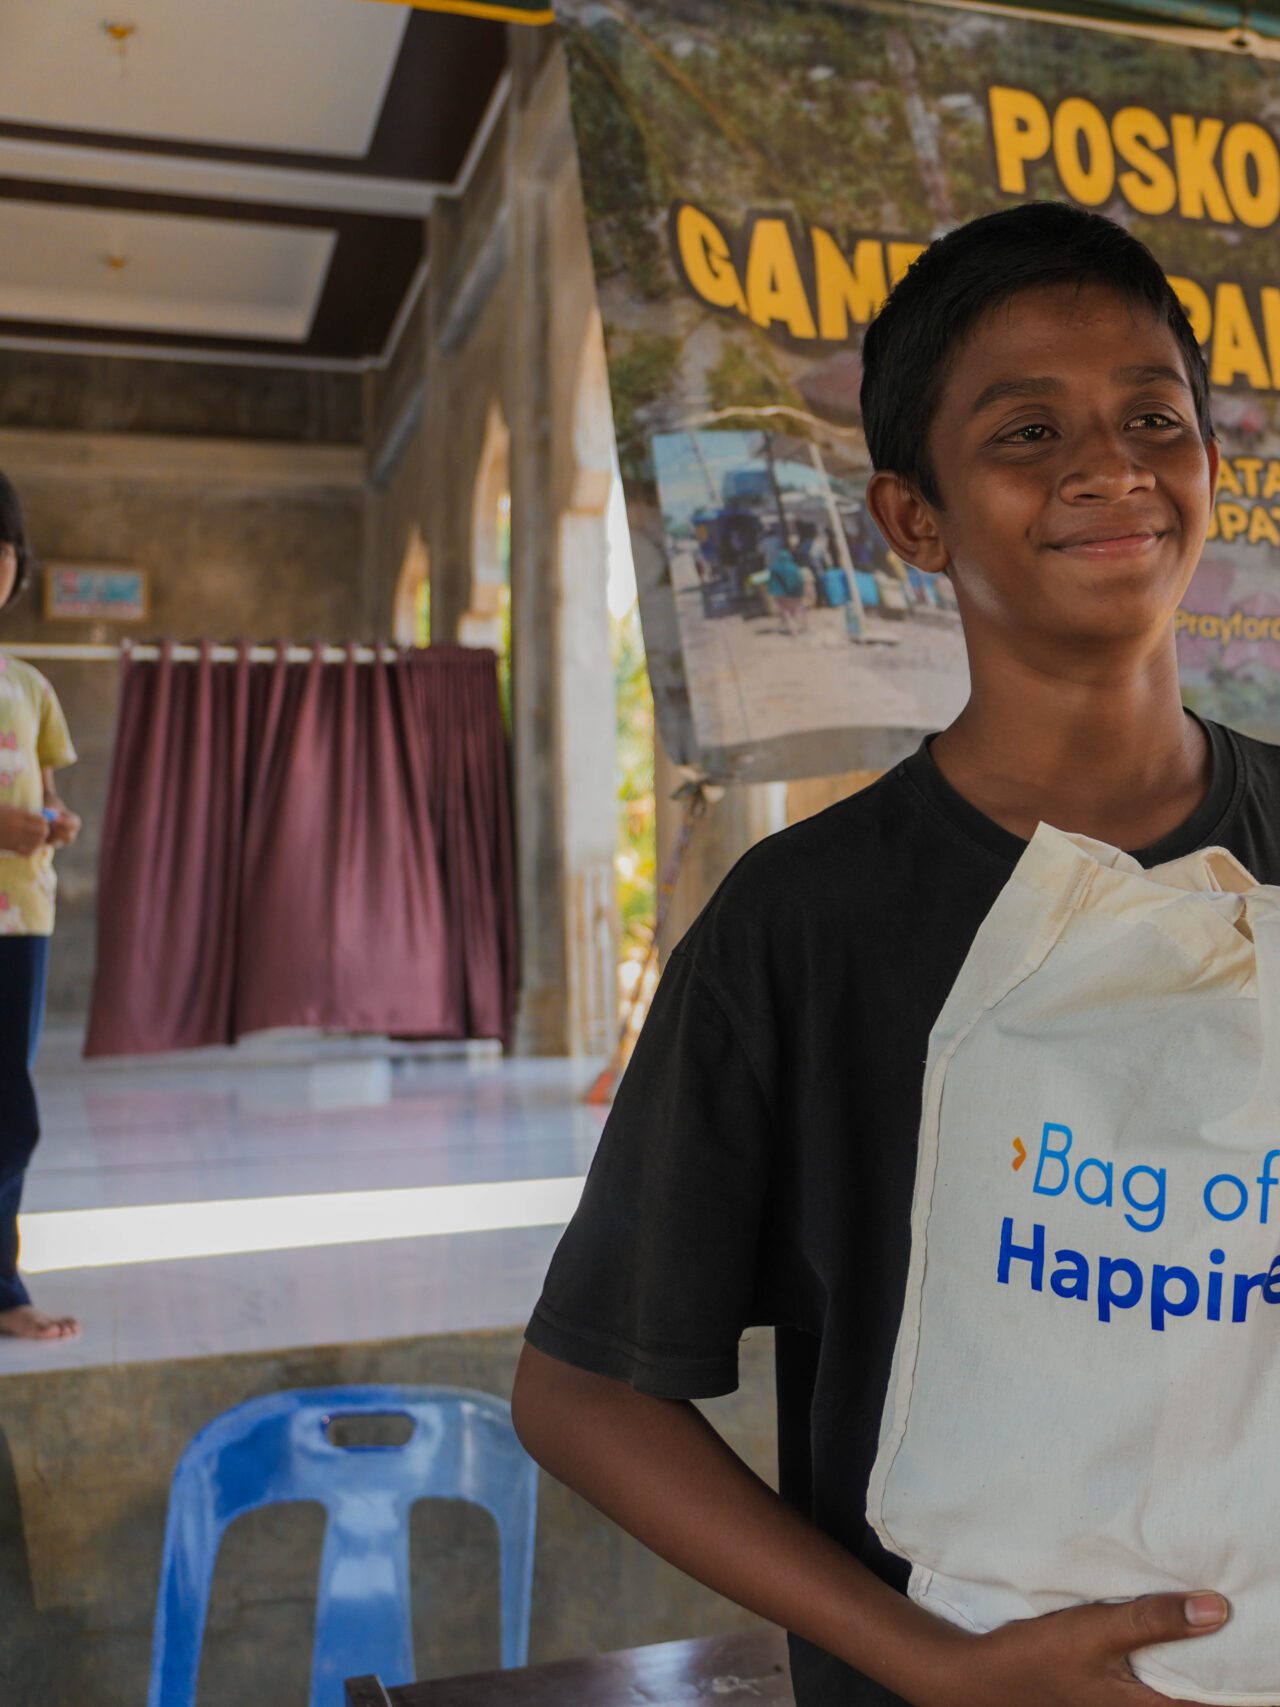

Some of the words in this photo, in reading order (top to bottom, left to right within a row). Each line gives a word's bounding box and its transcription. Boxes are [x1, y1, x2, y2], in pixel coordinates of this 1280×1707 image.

[678, 204, 928, 340] GAM
[1032, 1121, 1167, 1233] Bag
[1203, 1149, 1280, 1224] of
